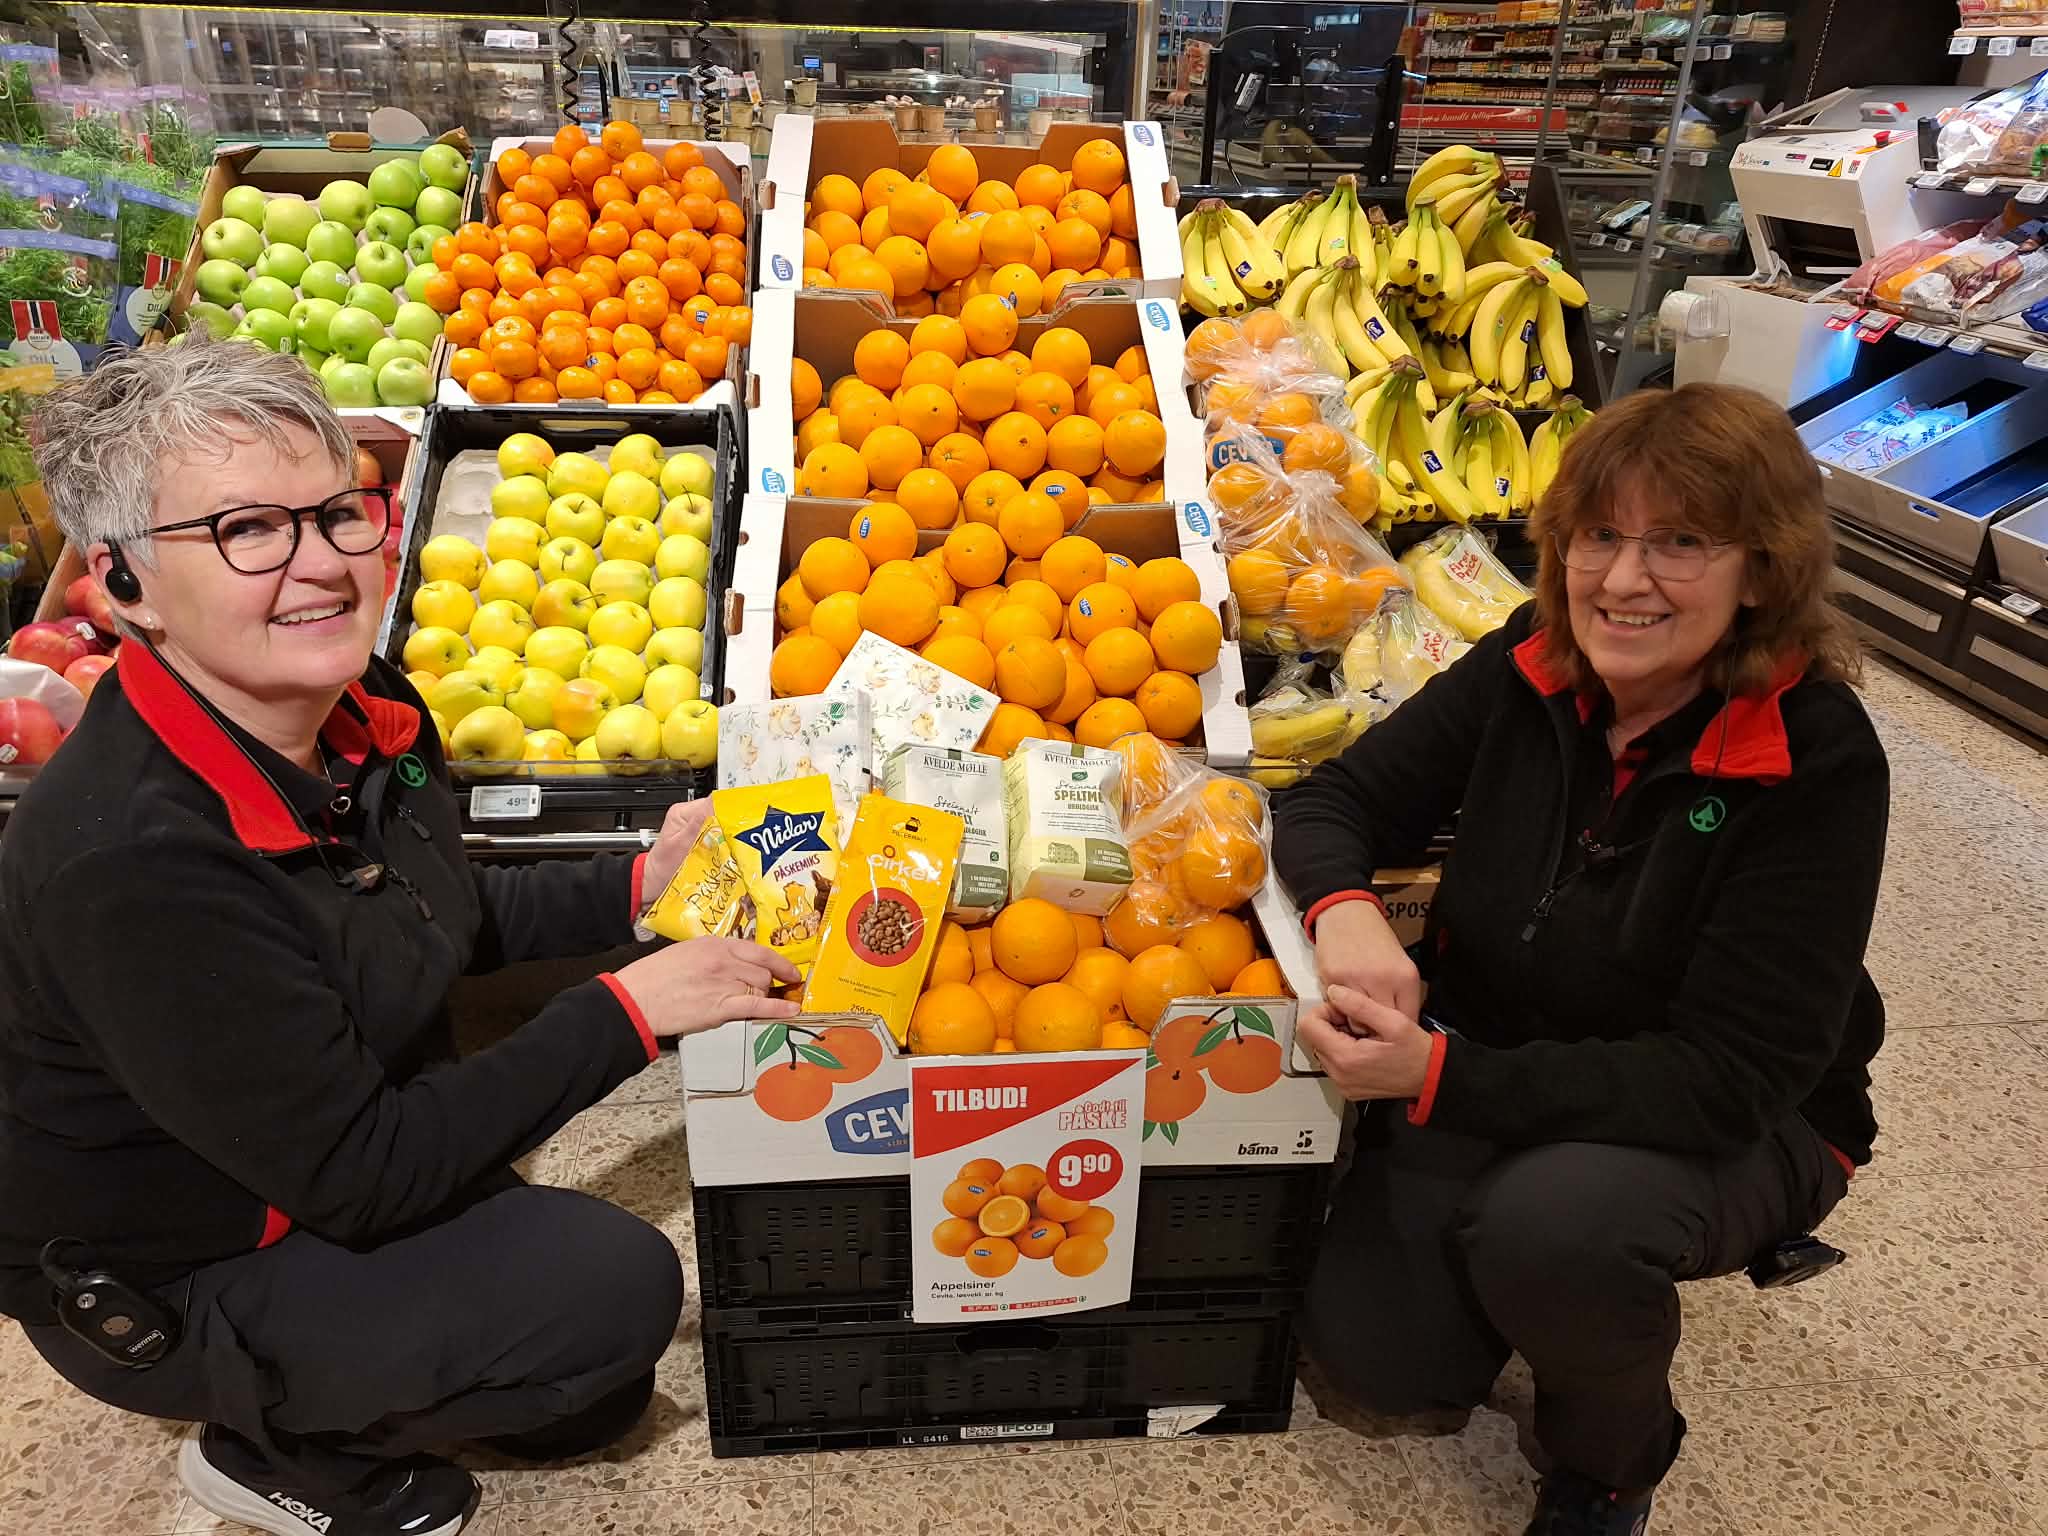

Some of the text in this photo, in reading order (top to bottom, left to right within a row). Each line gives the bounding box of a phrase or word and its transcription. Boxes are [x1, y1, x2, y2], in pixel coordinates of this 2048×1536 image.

[1188, 505, 1208, 534] CEVITA
[1448, 548, 1470, 574] First
[923, 755, 988, 774] KVELDE MØLLE
[750, 815, 818, 855] Nidar
[774, 854, 821, 881] PÅSKEMIKS
[932, 1086, 1028, 1113] TILBUD!
[1084, 1098, 1127, 1112] Godt til
[931, 1280, 996, 1291] Appelsiner
[902, 1436, 915, 1444] LL
[267, 1491, 333, 1534] HOKA
